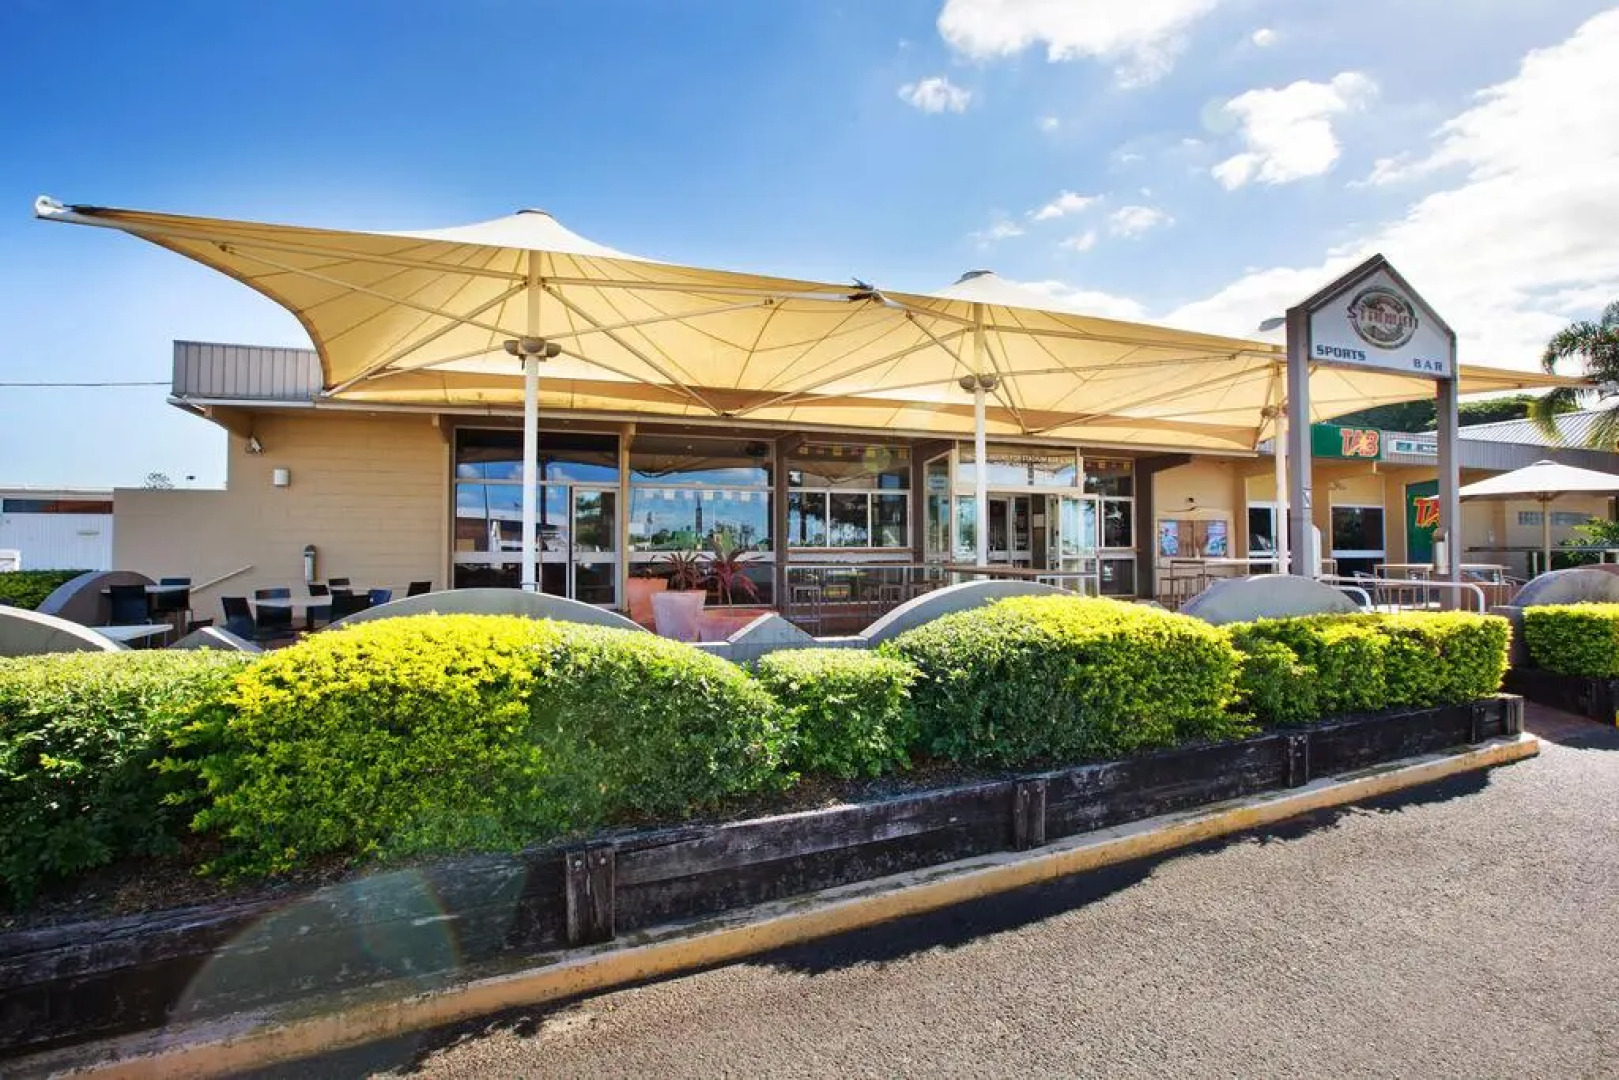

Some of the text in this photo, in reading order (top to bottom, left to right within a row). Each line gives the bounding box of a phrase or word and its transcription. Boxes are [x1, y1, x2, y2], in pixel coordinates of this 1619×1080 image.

[1316, 344, 1443, 371] SPORTS BAR
[1340, 428, 1380, 457] TAB
[1414, 496, 1439, 528] TA
